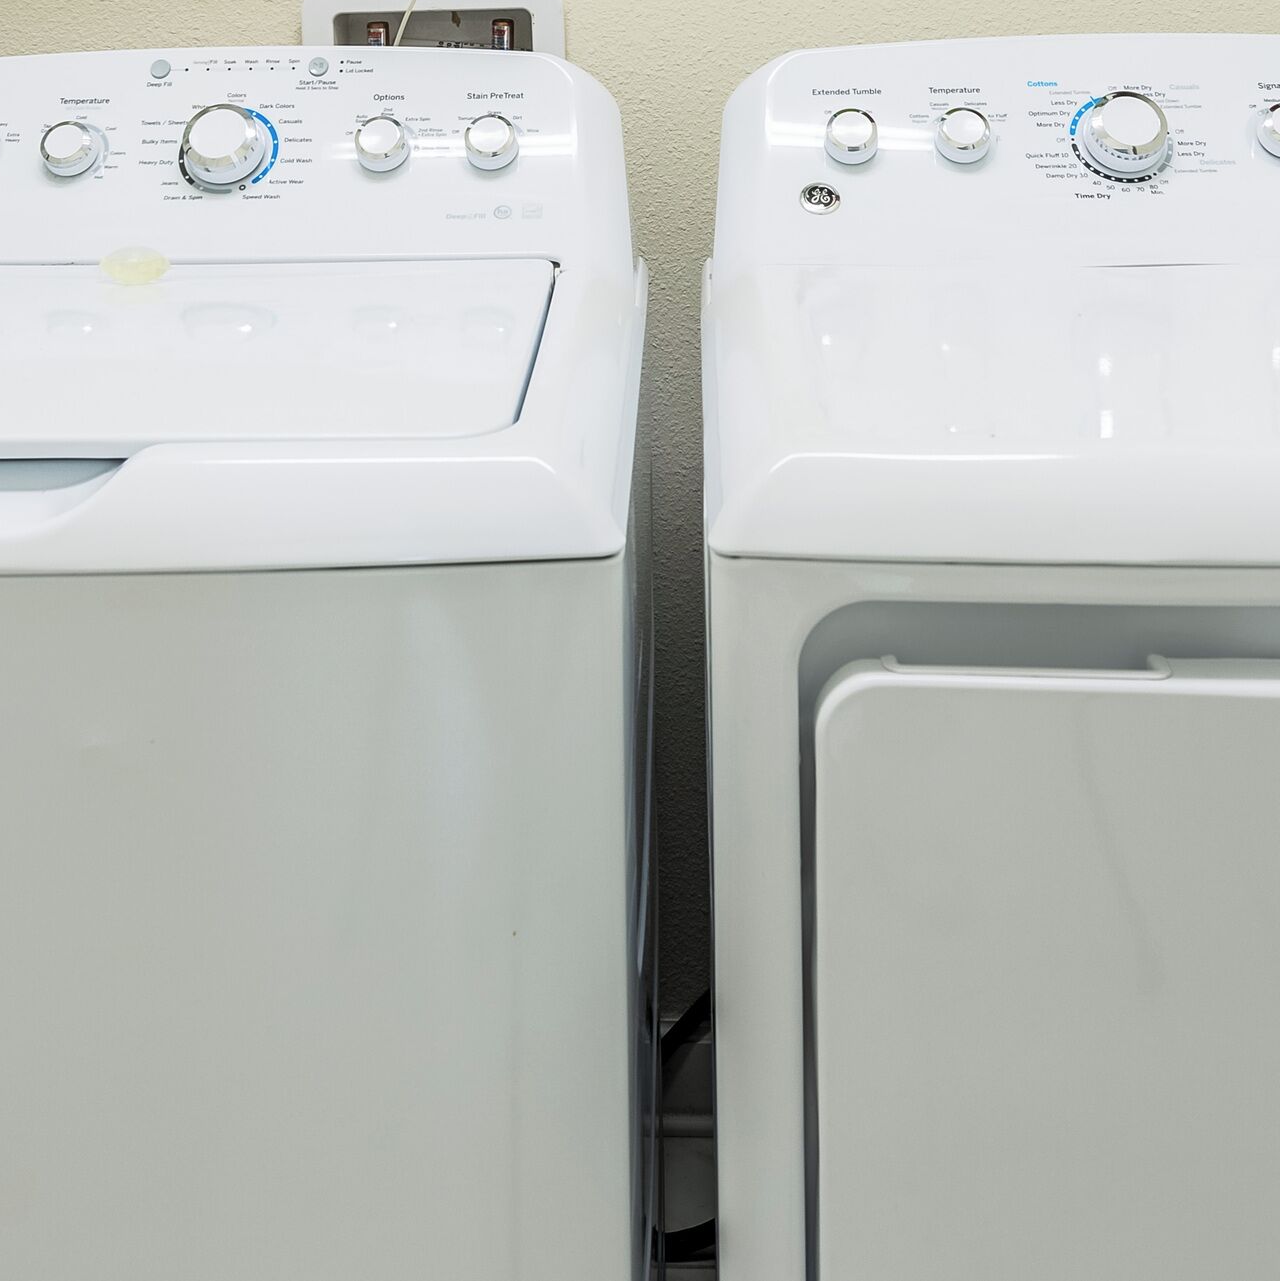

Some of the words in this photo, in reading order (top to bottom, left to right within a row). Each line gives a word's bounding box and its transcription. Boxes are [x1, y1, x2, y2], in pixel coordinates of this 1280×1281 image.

[929, 87, 981, 95] Temperature
[373, 94, 405, 102] Options
[467, 92, 488, 100] Stain
[60, 97, 110, 105] Temperature
